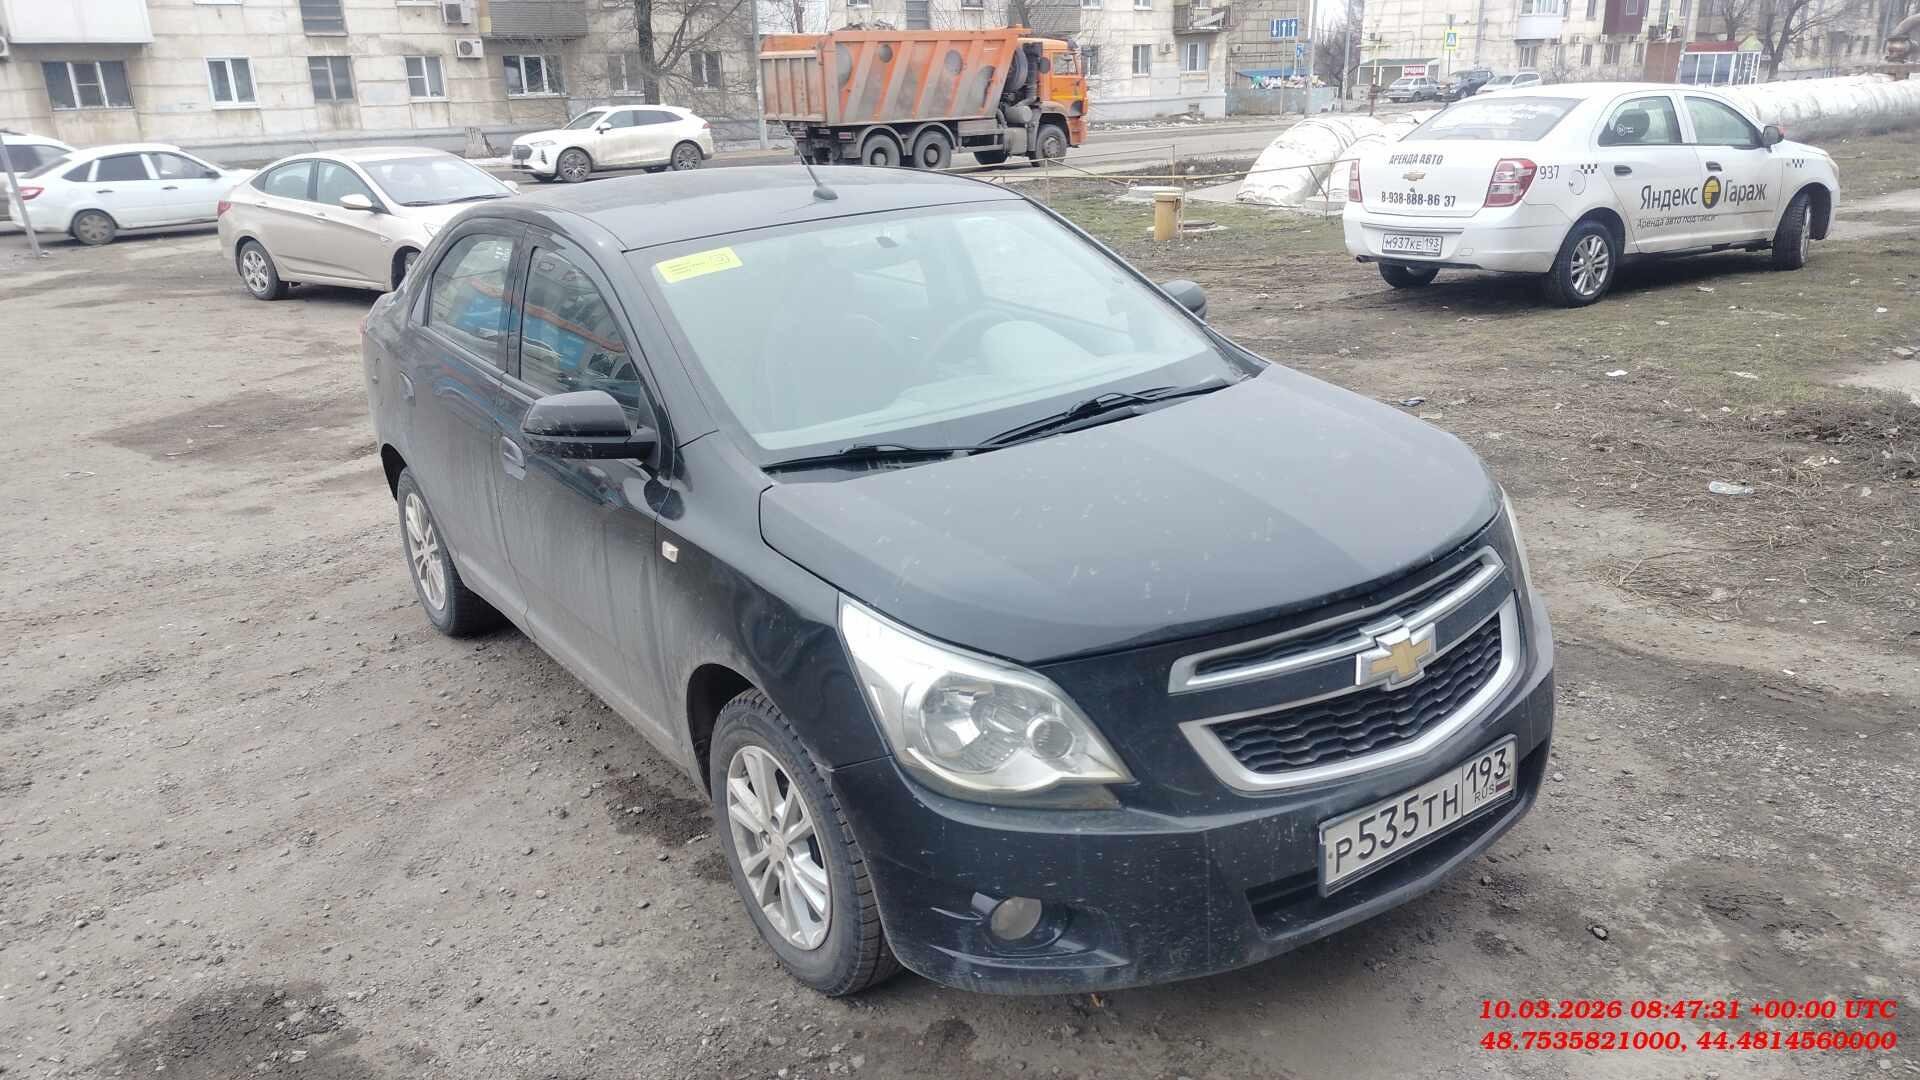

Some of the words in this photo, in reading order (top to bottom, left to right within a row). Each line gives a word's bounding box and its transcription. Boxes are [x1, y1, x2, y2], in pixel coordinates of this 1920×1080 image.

[1389, 153, 1418, 165] АРЕНДА
[1419, 154, 1444, 165] АВТО
[1539, 165, 1560, 180] 937
[1444, 195, 1456, 208] 37
[1640, 184, 1698, 211] Яндекс
[1724, 179, 1767, 206] Гараж
[1637, 216, 1664, 230] Аренда
[1666, 216, 1682, 226] авто
[1425, 239, 1438, 249] 193
[1474, 783, 1495, 804] RUS
[1335, 783, 1458, 874] Р535ТН
[1466, 747, 1507, 793] 193
